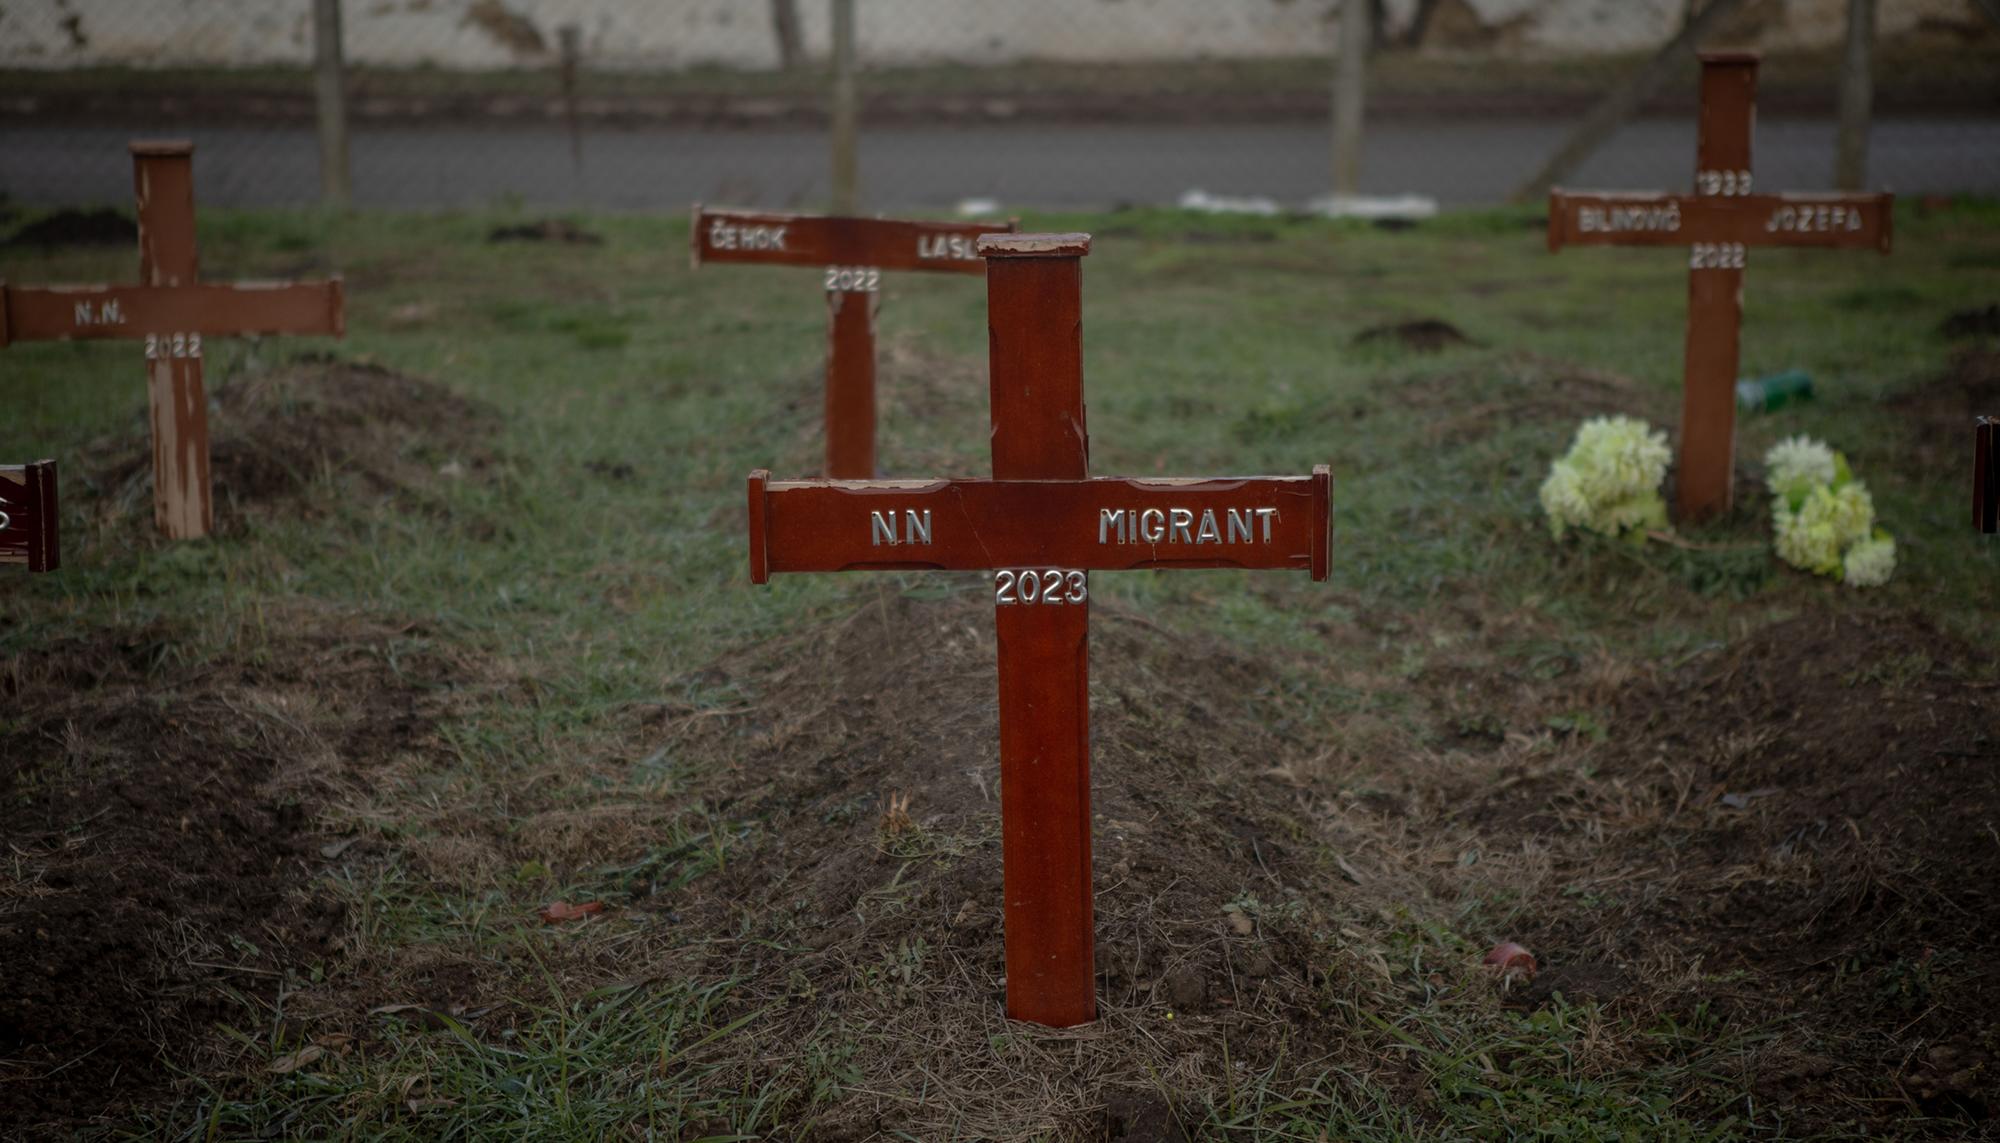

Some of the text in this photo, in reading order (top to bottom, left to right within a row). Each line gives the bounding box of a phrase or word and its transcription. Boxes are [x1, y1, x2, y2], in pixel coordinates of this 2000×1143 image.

[1765, 205, 1862, 233] JOZEFA
[711, 220, 978, 260] ČEHOK LASL
[1690, 241, 1745, 270] 2022
[824, 267, 880, 293] 2022
[74, 298, 126, 327] N.N.
[145, 332, 201, 359] 2022
[871, 507, 1278, 546] NN MIGRANT
[995, 568, 1088, 606] 2023
